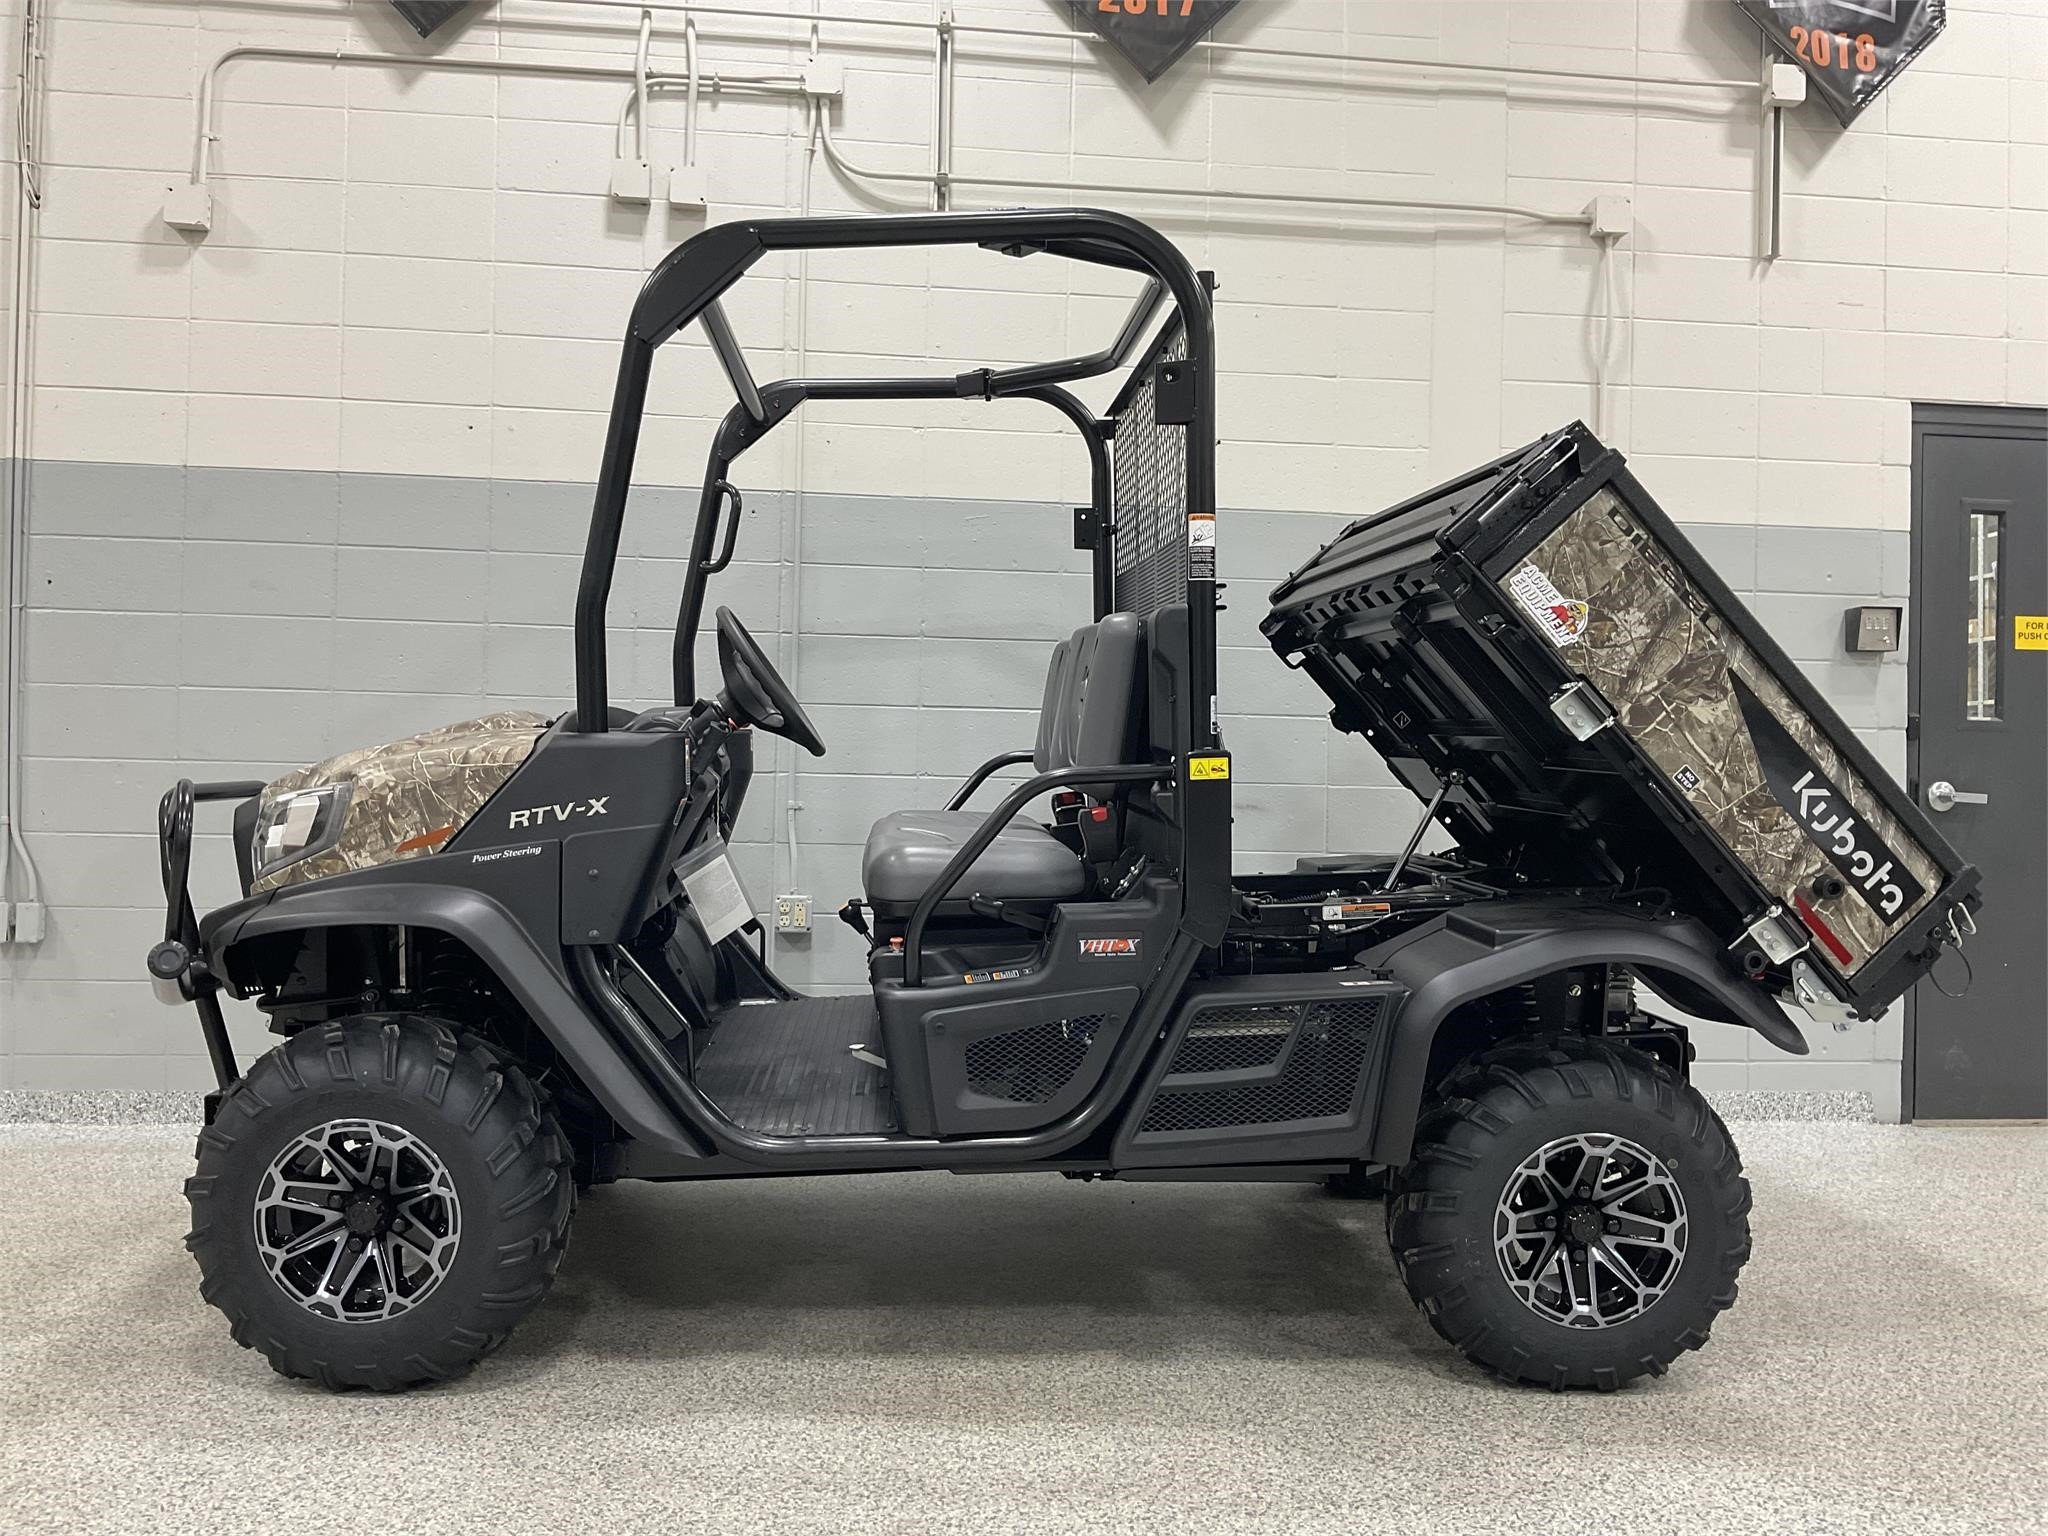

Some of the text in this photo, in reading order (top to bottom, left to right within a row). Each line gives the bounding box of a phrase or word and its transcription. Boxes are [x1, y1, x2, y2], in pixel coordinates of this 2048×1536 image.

[1789, 25, 1877, 73] 2018
[1523, 566, 1560, 604] ACME
[1513, 576, 1577, 644] EQUIPMENT
[2018, 632, 2042, 640] PUSH
[2026, 622, 2044, 630] FOR
[1677, 773, 1693, 789] STEP
[1684, 771, 1695, 782] NO
[508, 795, 610, 830] RTV-X
[472, 846, 542, 864] Power Steering
[1791, 770, 1904, 915] Kubota
